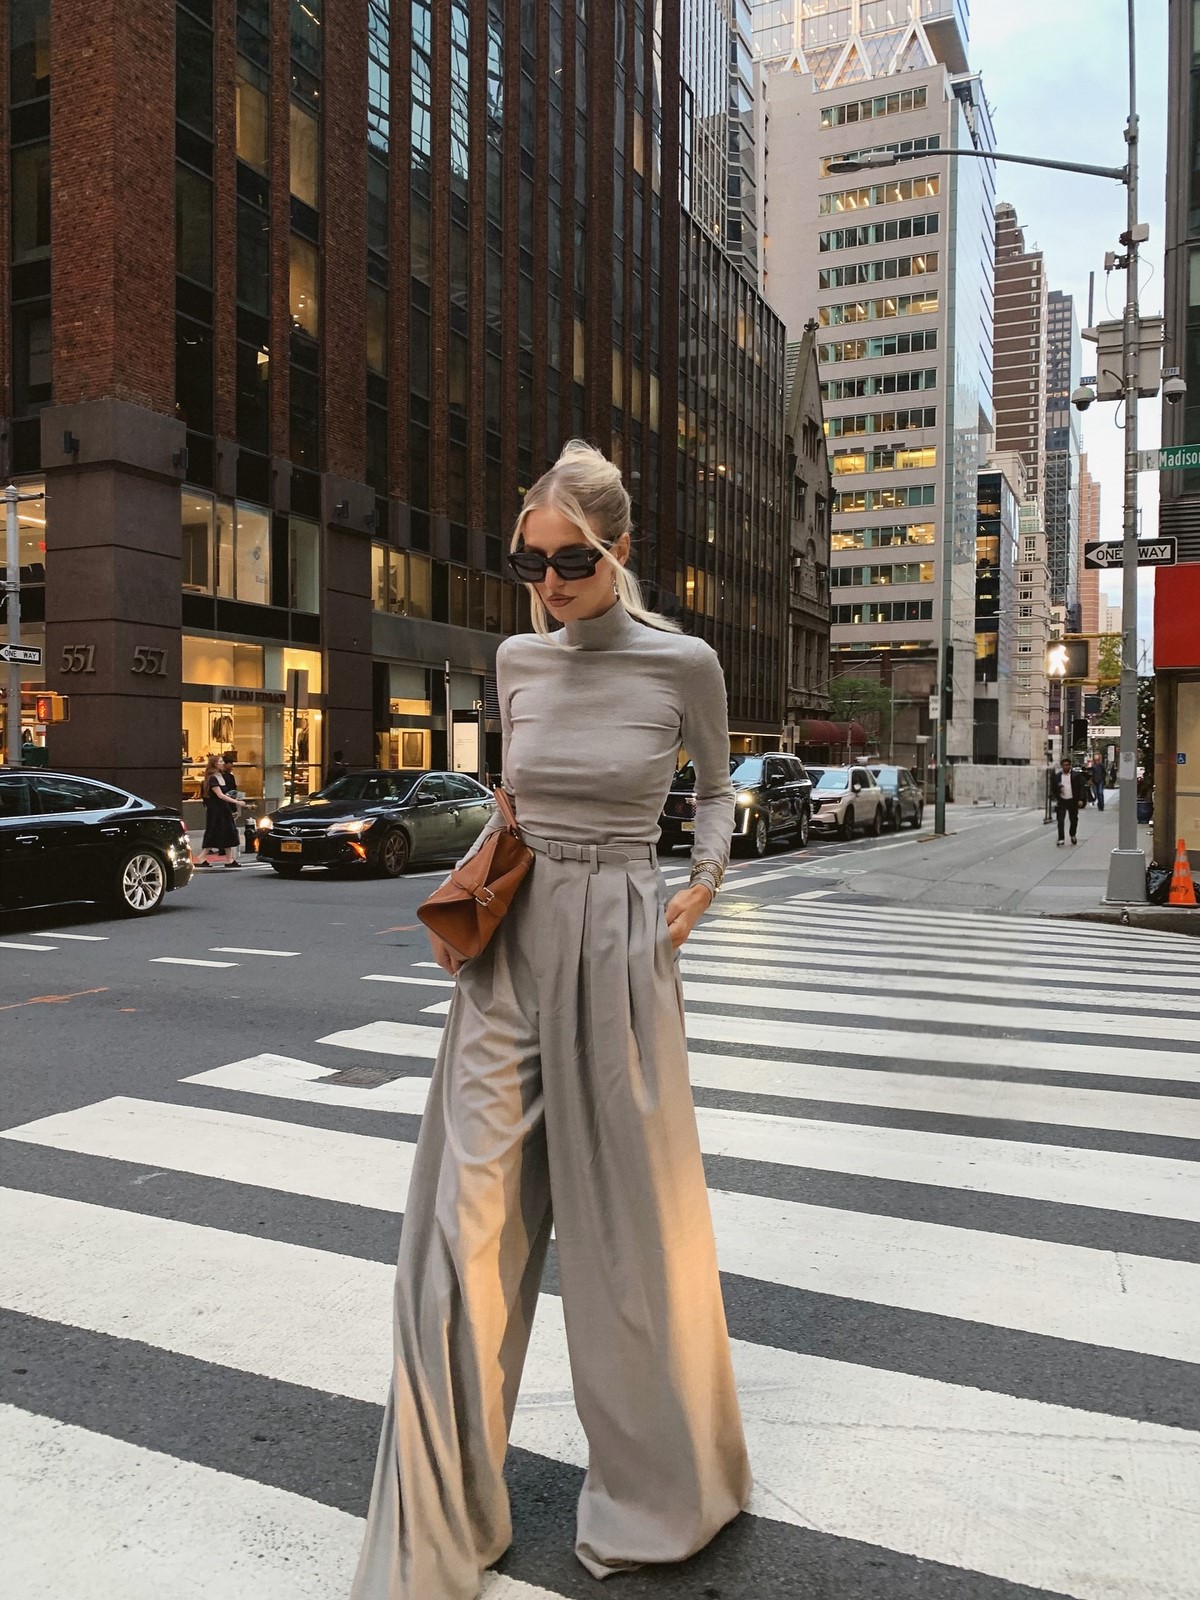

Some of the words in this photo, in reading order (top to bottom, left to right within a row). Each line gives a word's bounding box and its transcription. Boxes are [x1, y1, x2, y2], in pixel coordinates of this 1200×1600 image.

[1159, 449, 1200, 467] Madiso
[1096, 549, 1123, 561] ONE
[1138, 546, 1168, 559] WAY
[4, 650, 17, 658] ONE
[59, 644, 97, 674] 551
[130, 645, 169, 676] 551
[220, 689, 253, 701] ALLEN
